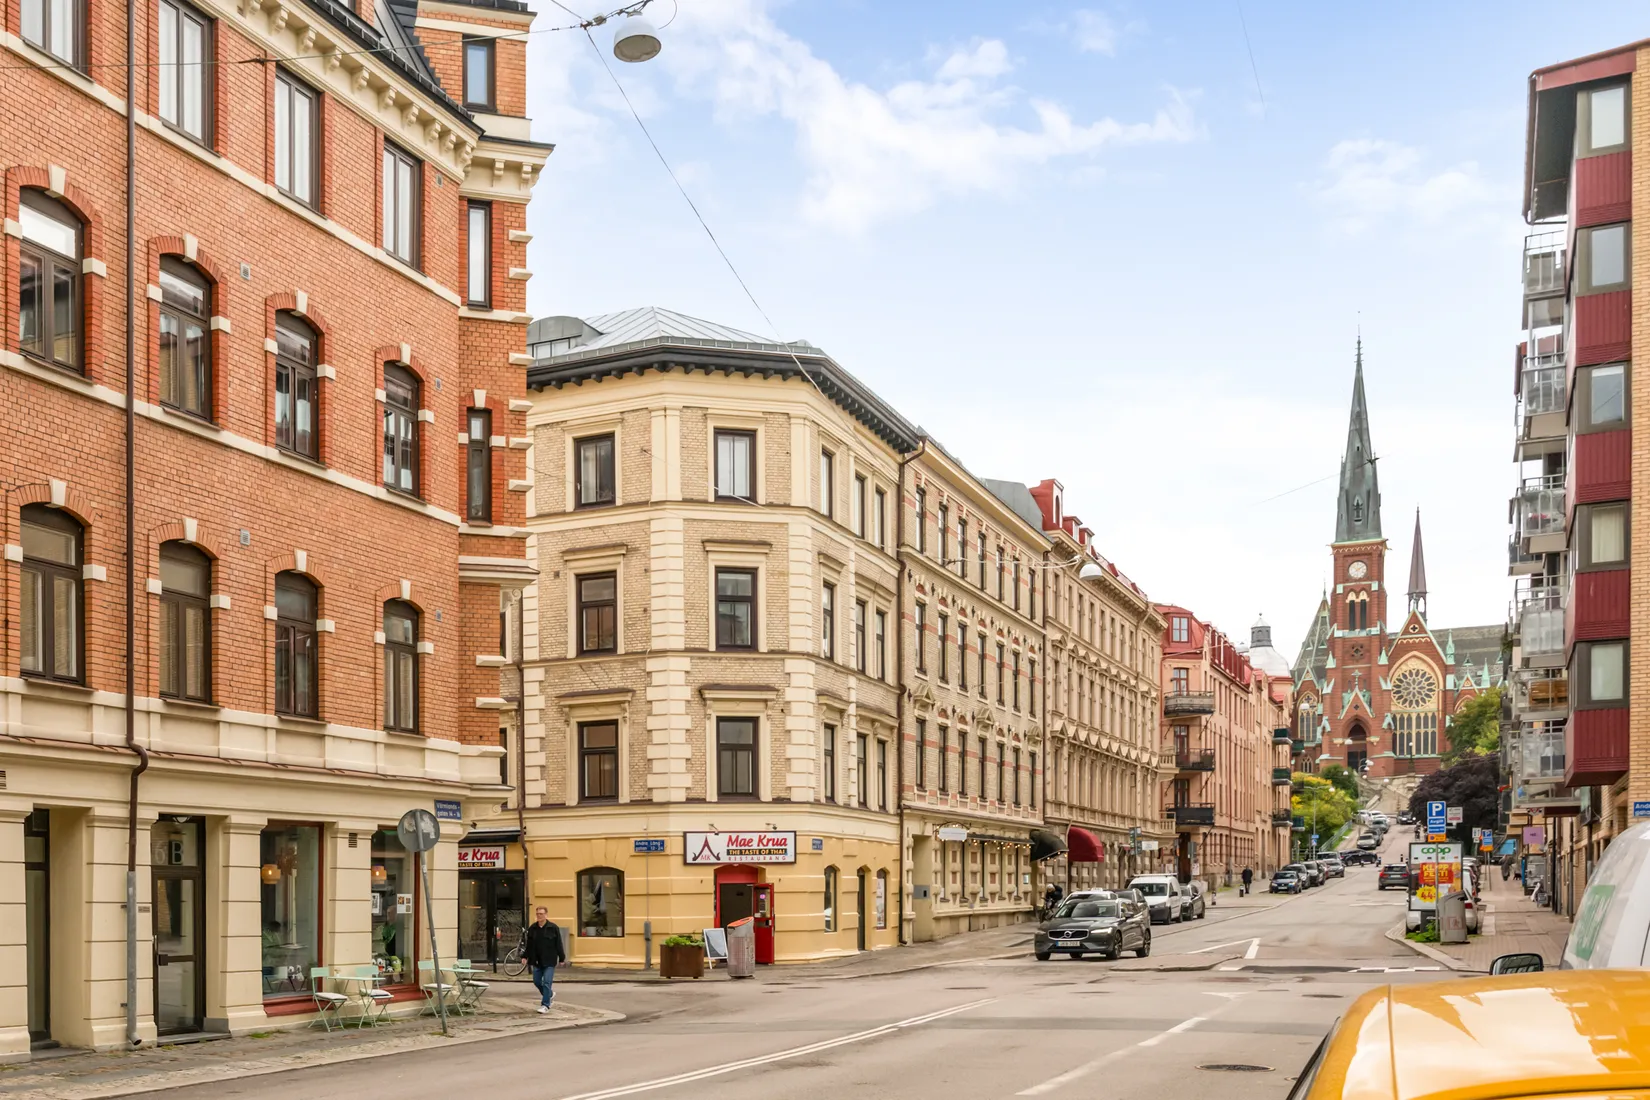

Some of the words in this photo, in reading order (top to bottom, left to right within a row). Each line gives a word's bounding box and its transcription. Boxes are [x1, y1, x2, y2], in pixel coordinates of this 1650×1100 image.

[1432, 803, 1442, 816] P
[726, 834, 753, 848] Mae
[757, 834, 788, 847] Krua
[472, 849, 500, 860] Krua
